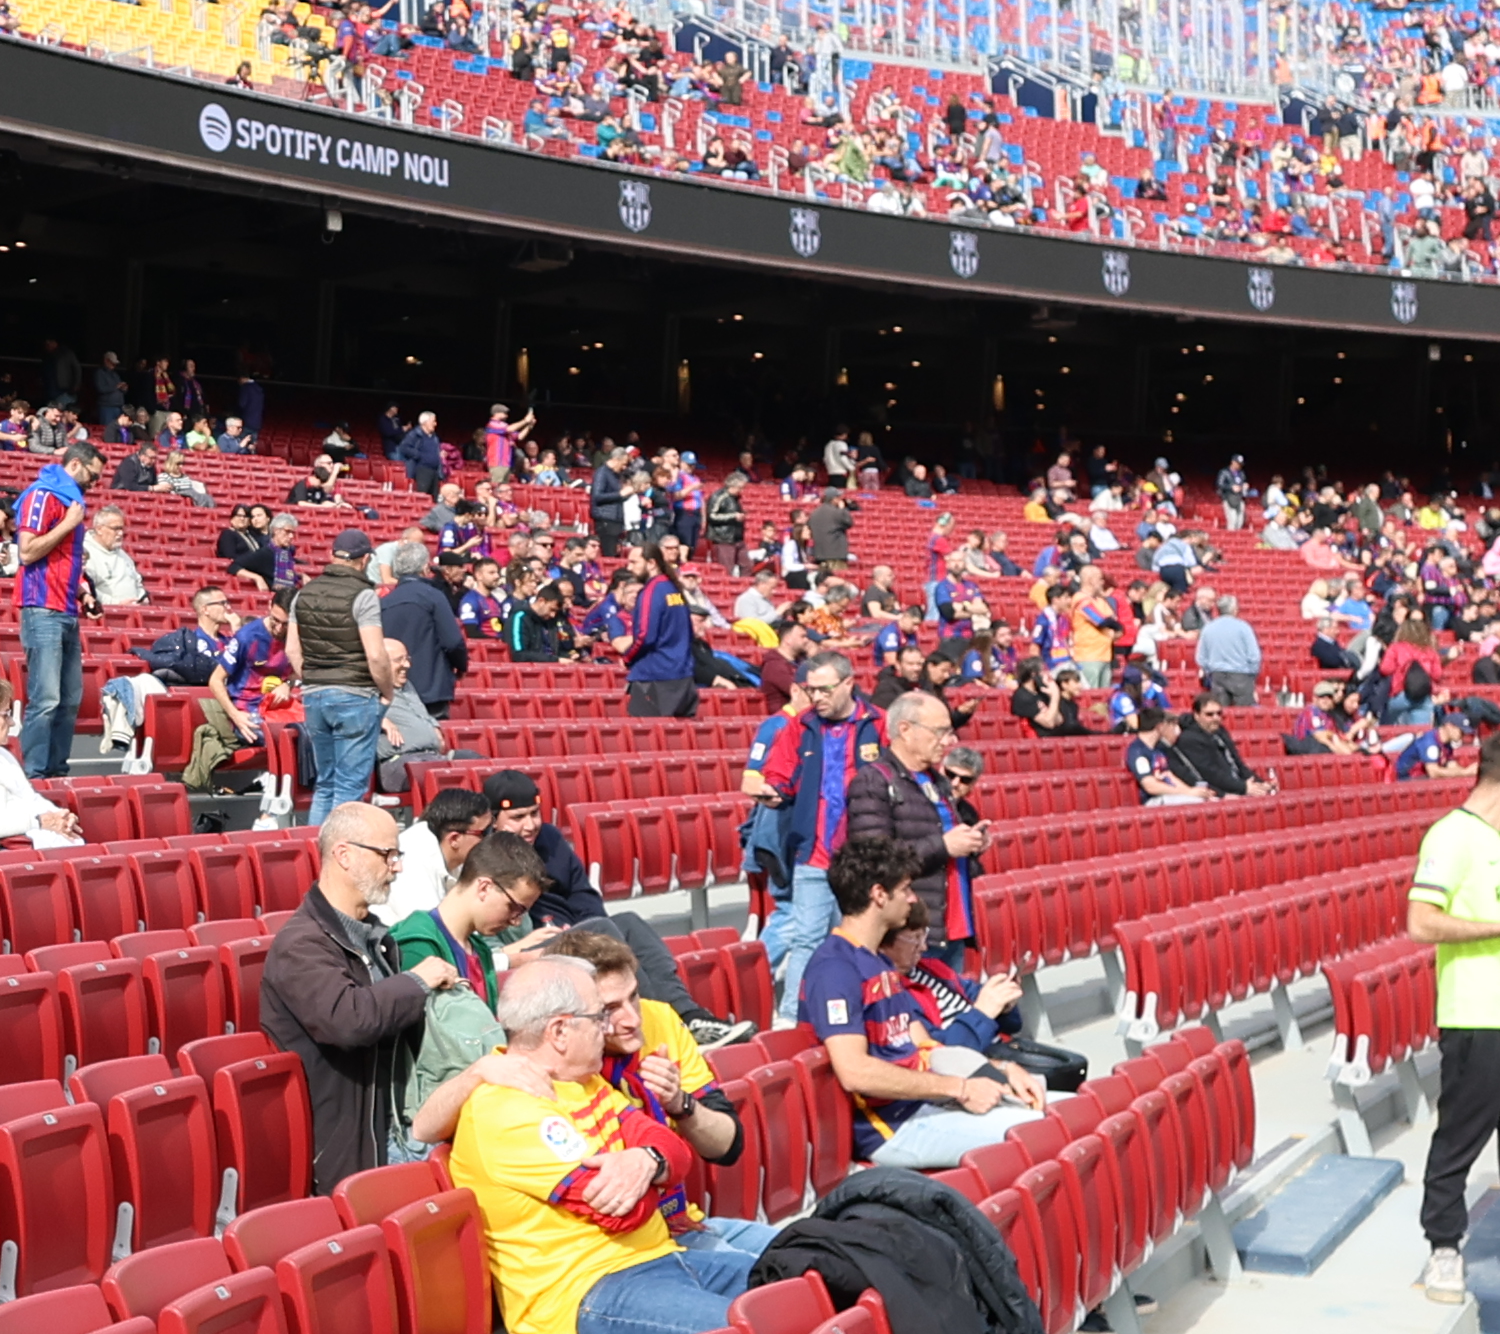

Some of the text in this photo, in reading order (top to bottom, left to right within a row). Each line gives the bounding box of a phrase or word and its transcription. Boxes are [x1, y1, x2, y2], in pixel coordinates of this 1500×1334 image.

[235, 117, 449, 187] SPOTIFY CAMP NOU
